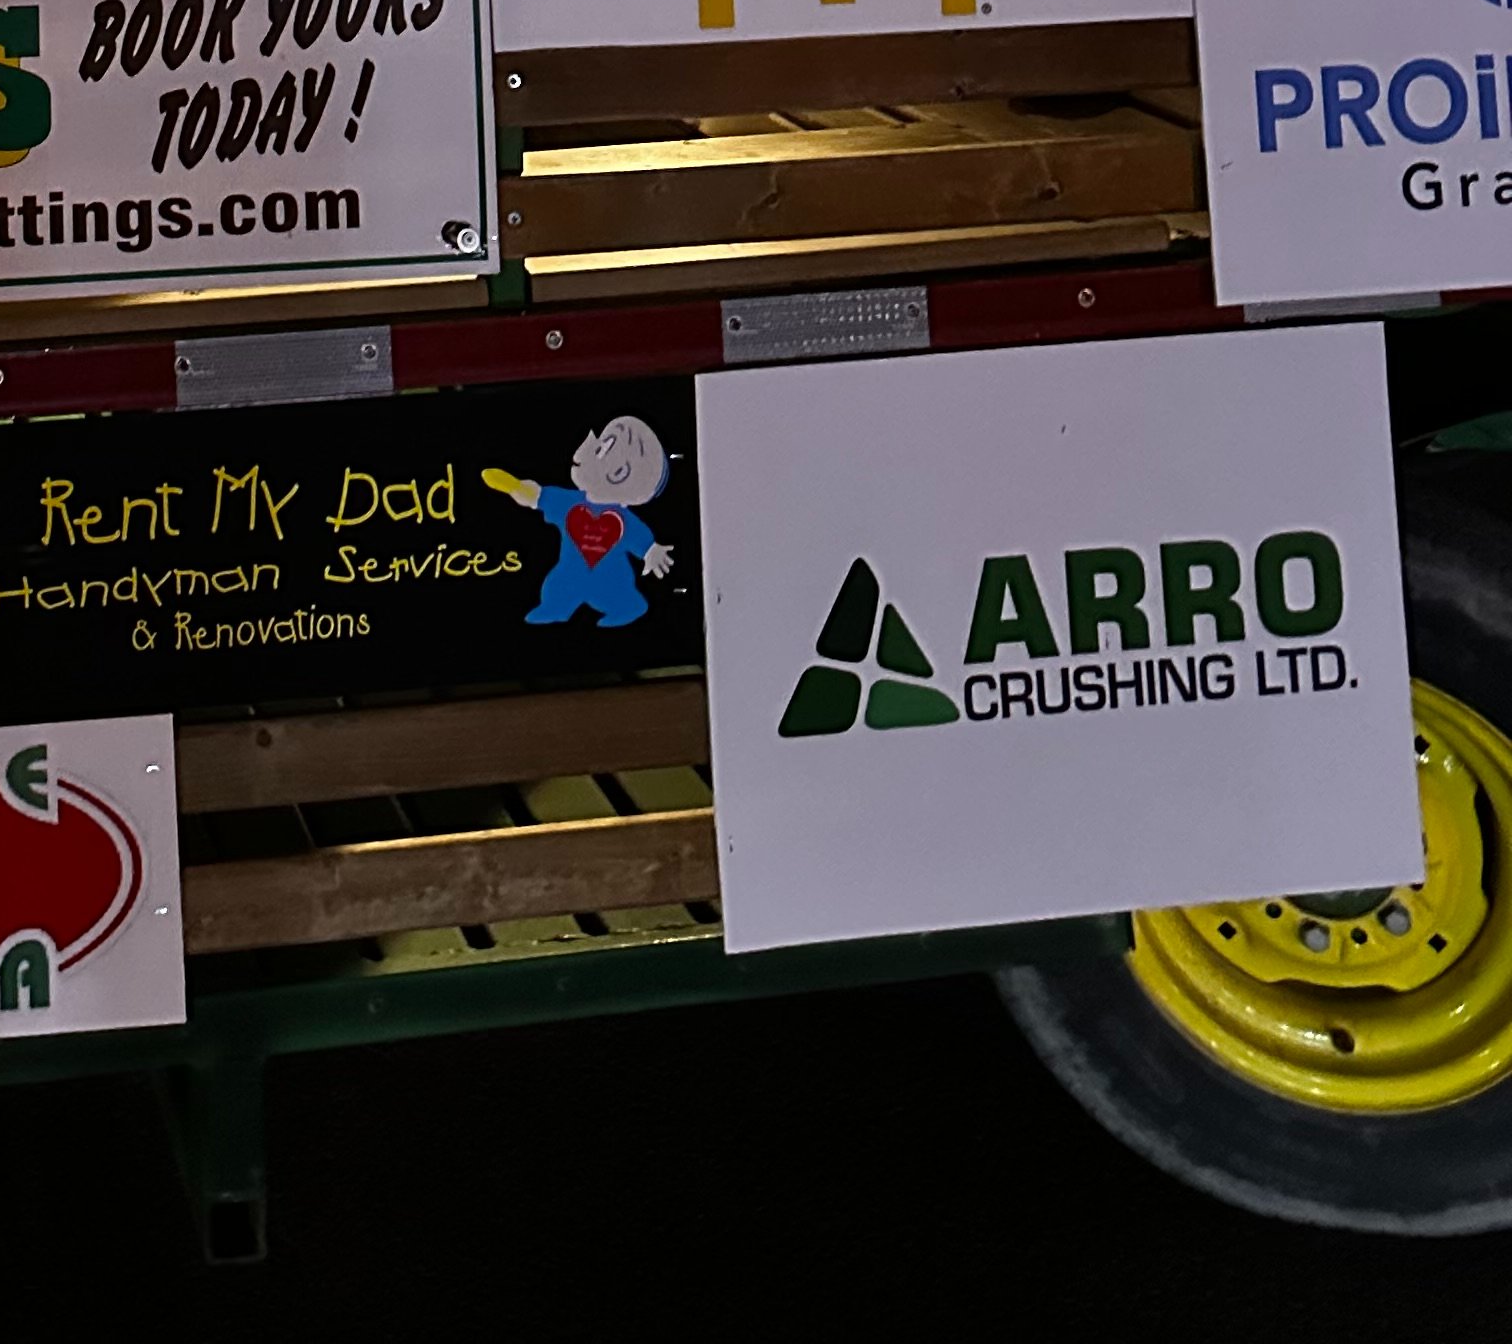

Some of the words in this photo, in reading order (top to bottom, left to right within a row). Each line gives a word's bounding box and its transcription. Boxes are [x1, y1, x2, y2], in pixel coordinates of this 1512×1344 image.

[41, 477, 182, 546] Rent
[326, 463, 456, 533] Dad
[324, 545, 523, 584] Services
[963, 530, 1344, 665] ARRO
[131, 619, 155, 651] &
[174, 604, 371, 650] Renovations
[963, 654, 1236, 720] CRUSHING
[1255, 644, 1359, 696] LTD.
